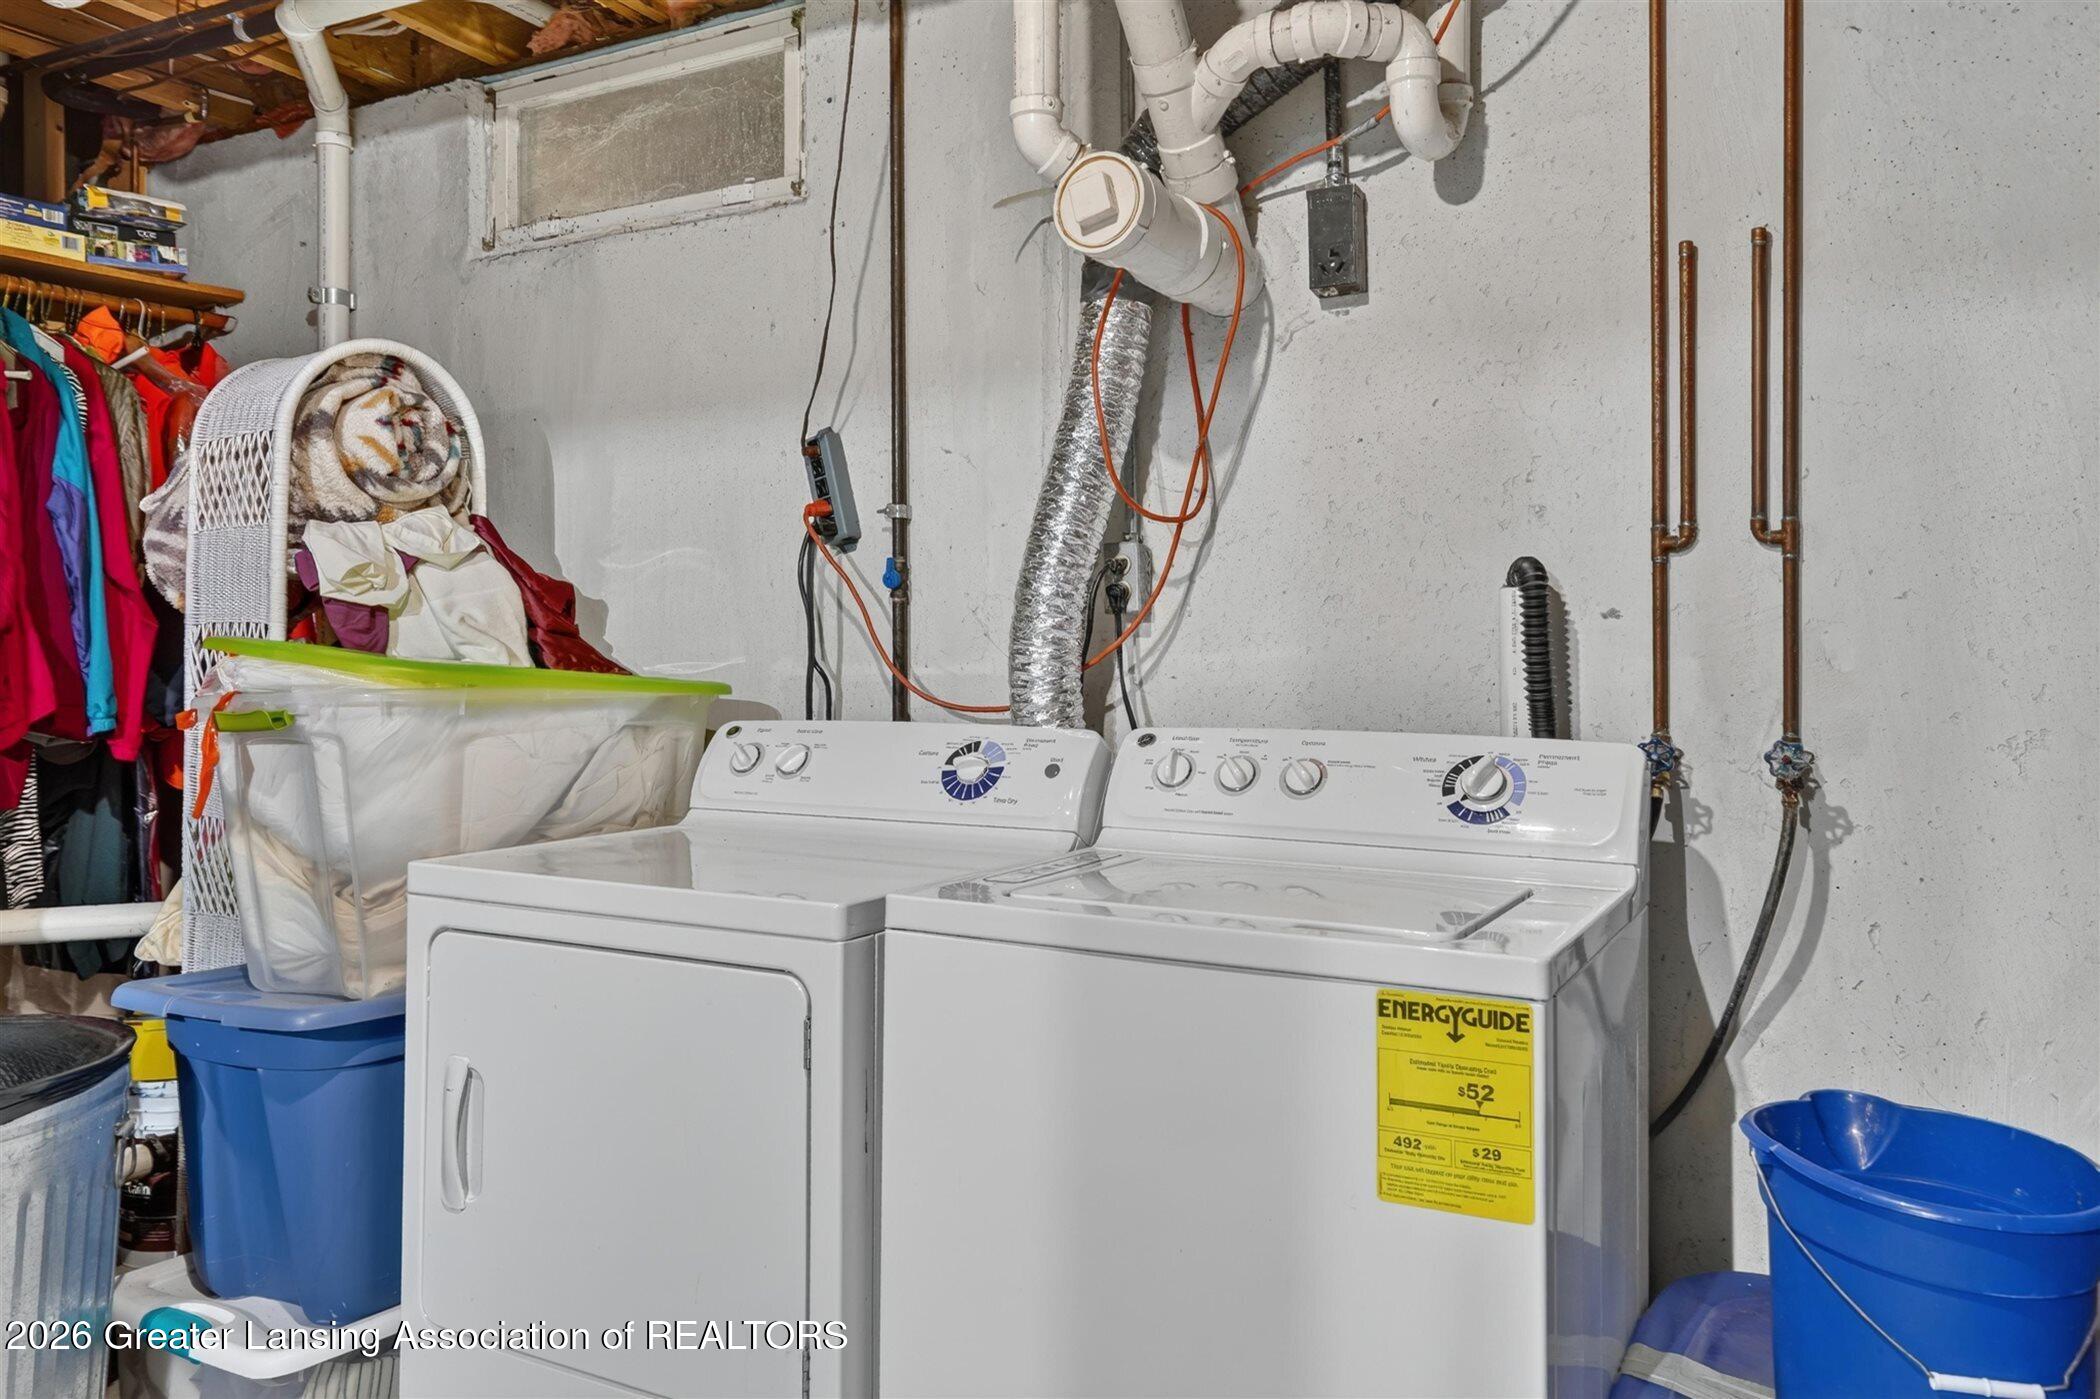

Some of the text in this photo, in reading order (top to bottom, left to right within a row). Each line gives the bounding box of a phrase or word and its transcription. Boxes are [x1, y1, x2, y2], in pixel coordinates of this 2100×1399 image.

[1377, 997, 1530, 1034] ENERGYGUIDE
[1457, 1082, 1495, 1103] $52
[1393, 1135, 1422, 1151] 492
